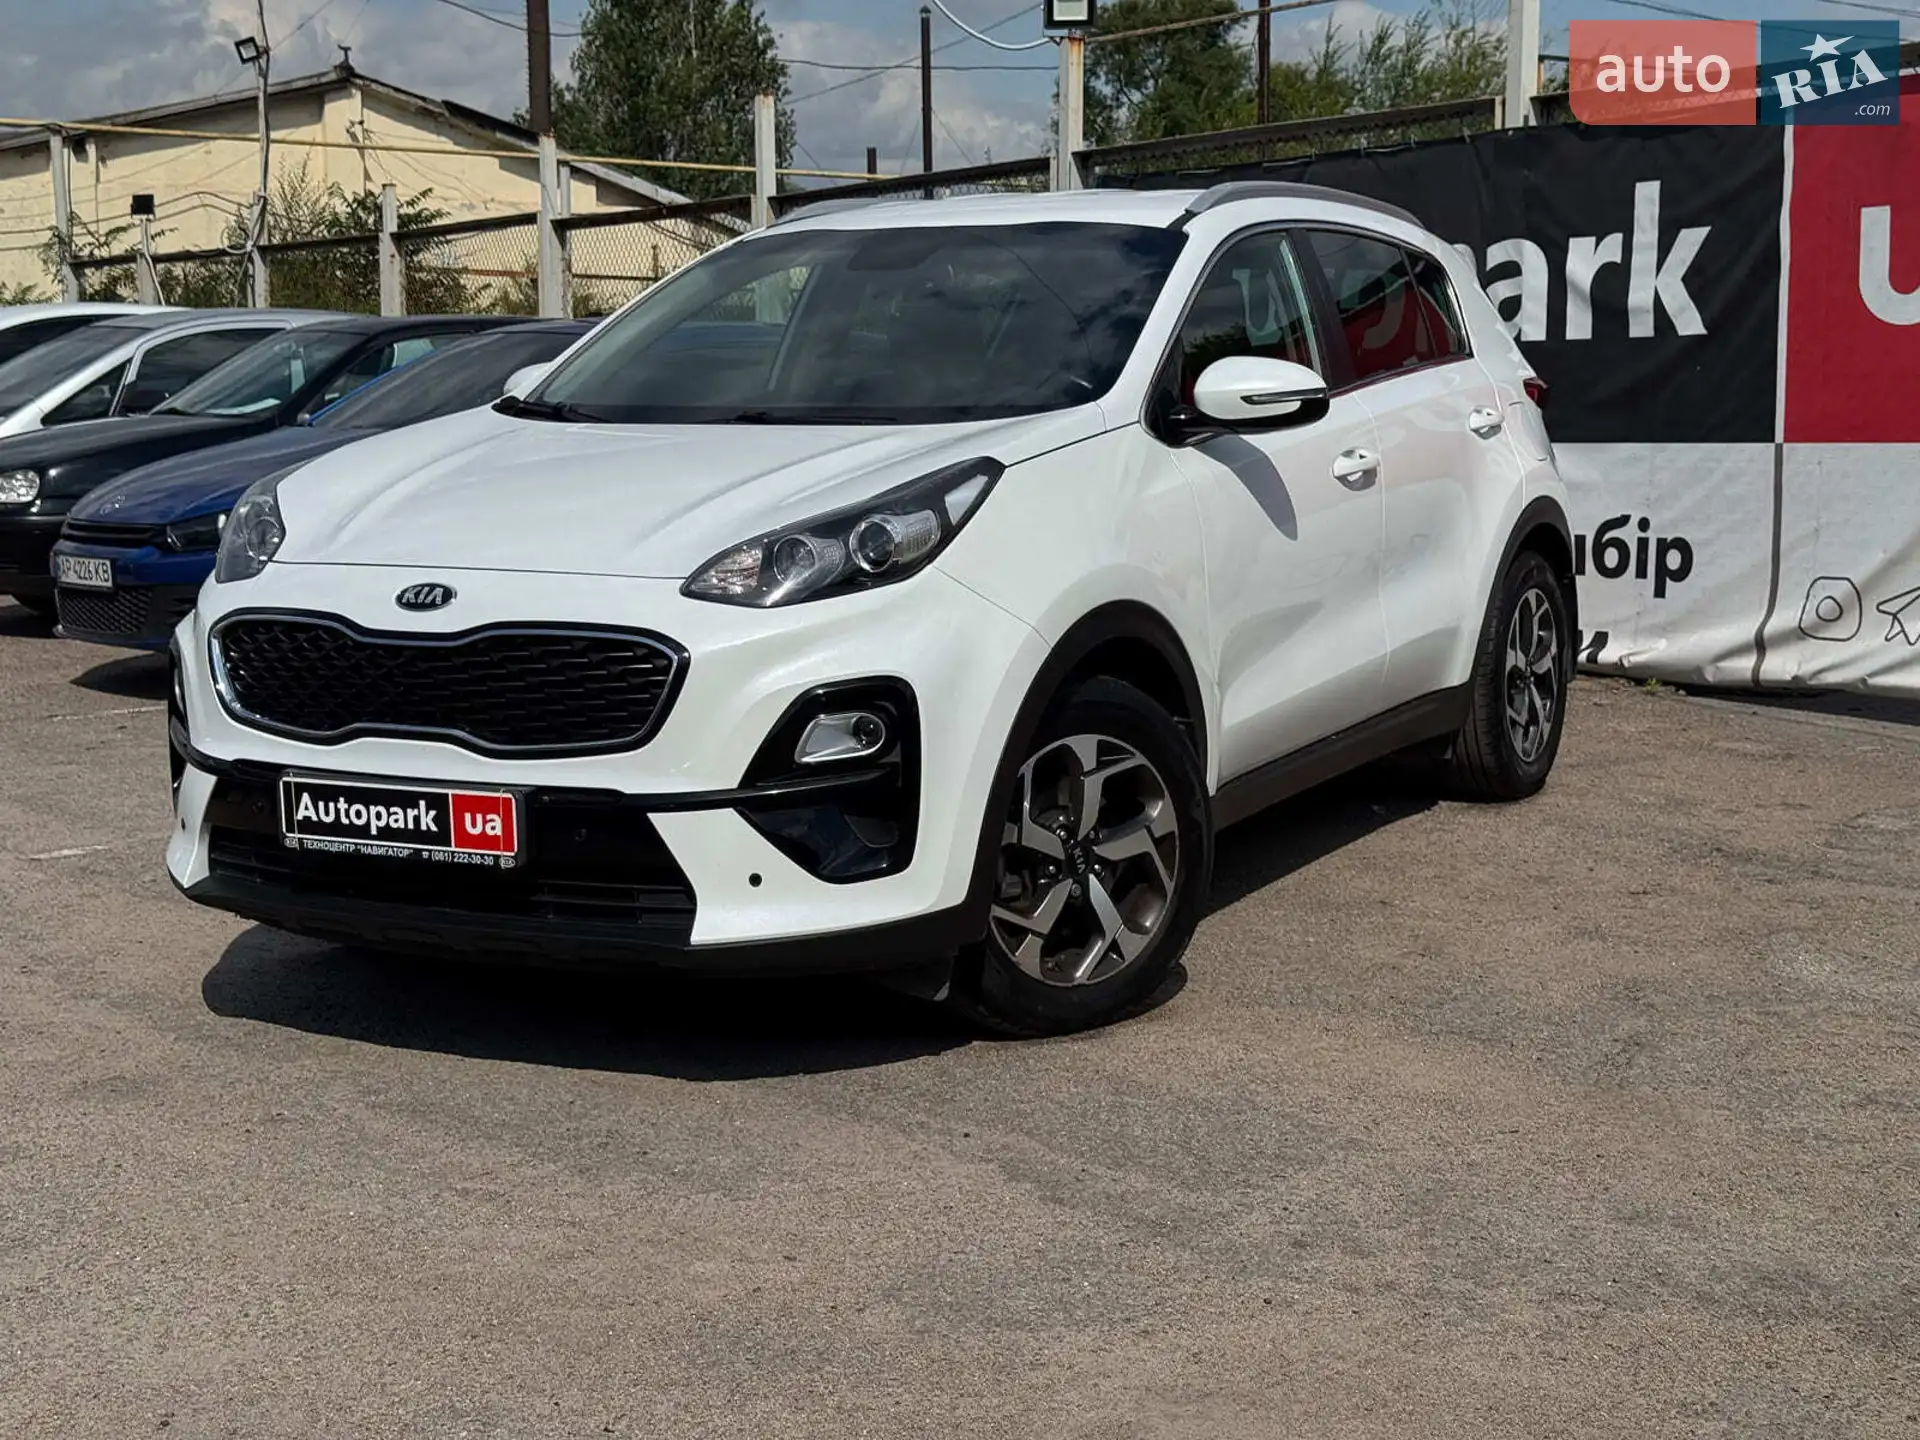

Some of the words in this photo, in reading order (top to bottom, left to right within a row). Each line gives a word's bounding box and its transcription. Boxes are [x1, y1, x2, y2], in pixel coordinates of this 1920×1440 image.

[1452, 180, 1712, 342] ark
[401, 586, 444, 605] KIA
[296, 792, 439, 835] Autopark
[463, 811, 502, 836] ua
[303, 839, 355, 853] ТЕХНОЦЕНТР
[453, 852, 494, 865] 222-30-30
